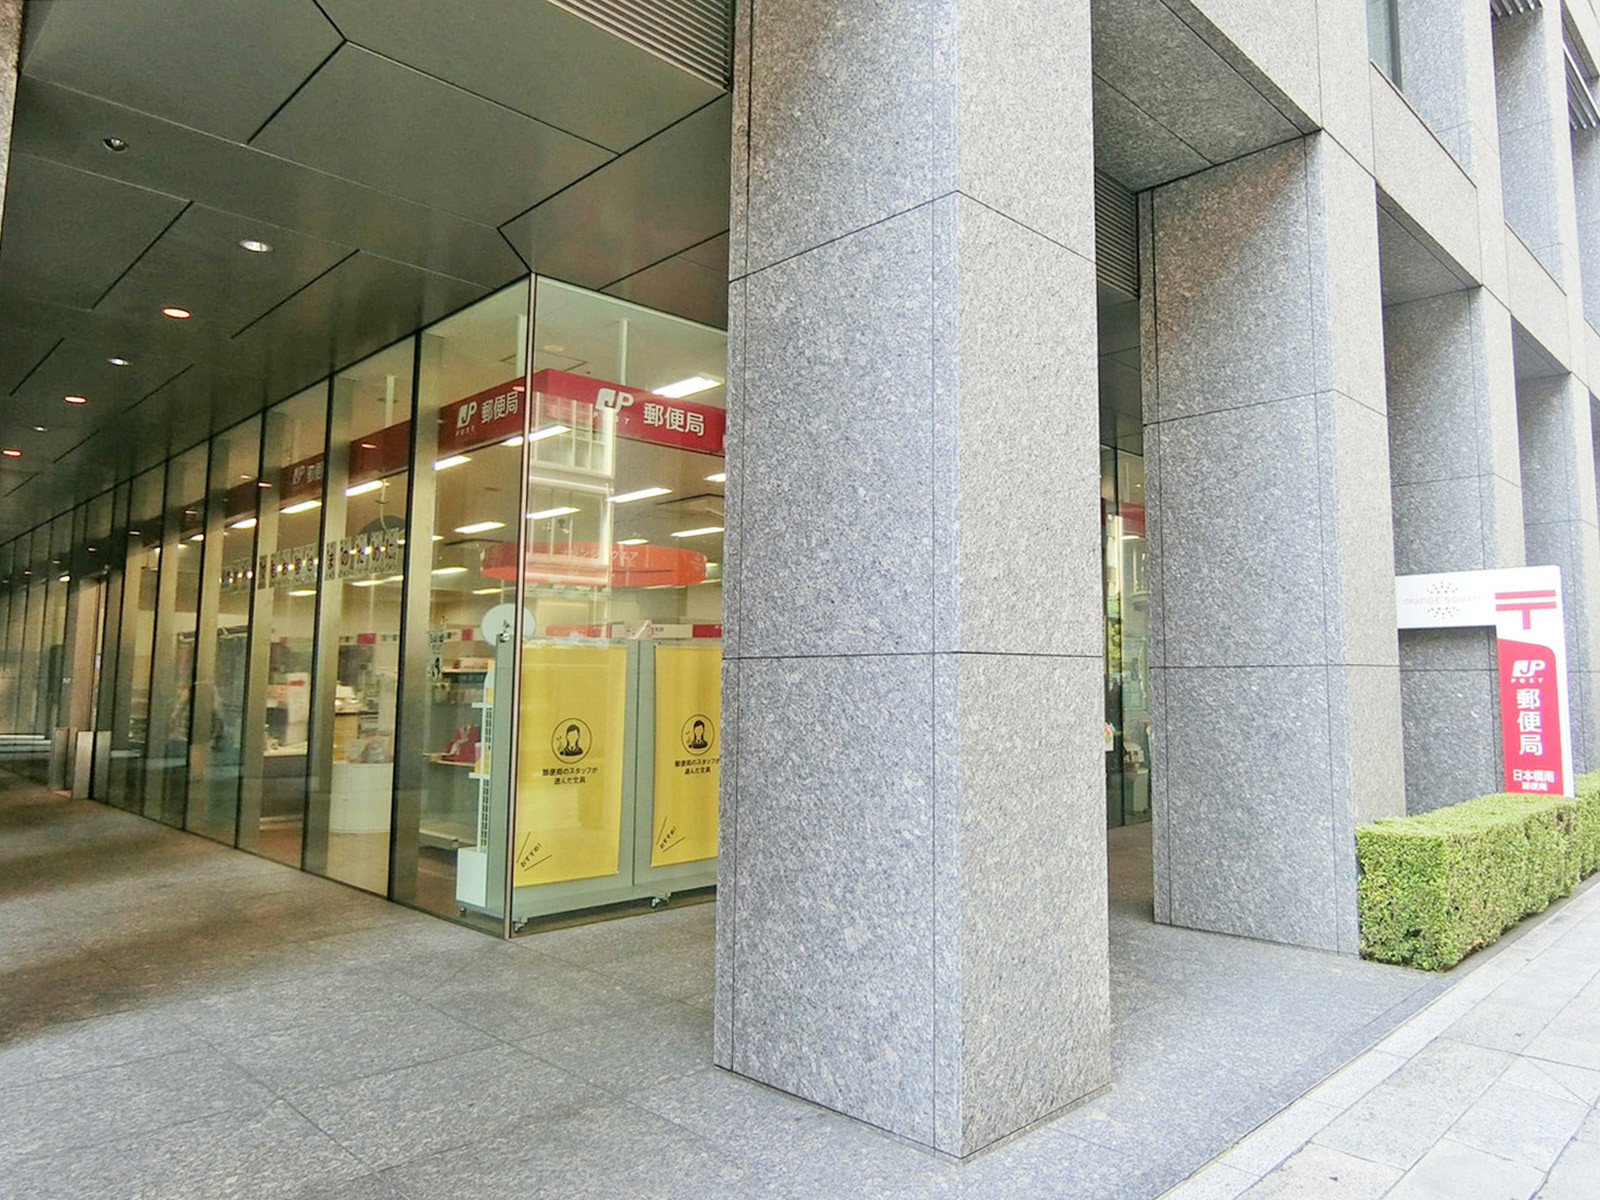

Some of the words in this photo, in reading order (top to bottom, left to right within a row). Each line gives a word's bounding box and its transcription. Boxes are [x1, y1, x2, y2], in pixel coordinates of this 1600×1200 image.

[481, 391, 518, 424] 郵便局
[643, 402, 705, 437] 郵便局
[1516, 688, 1543, 756] 郵便局
